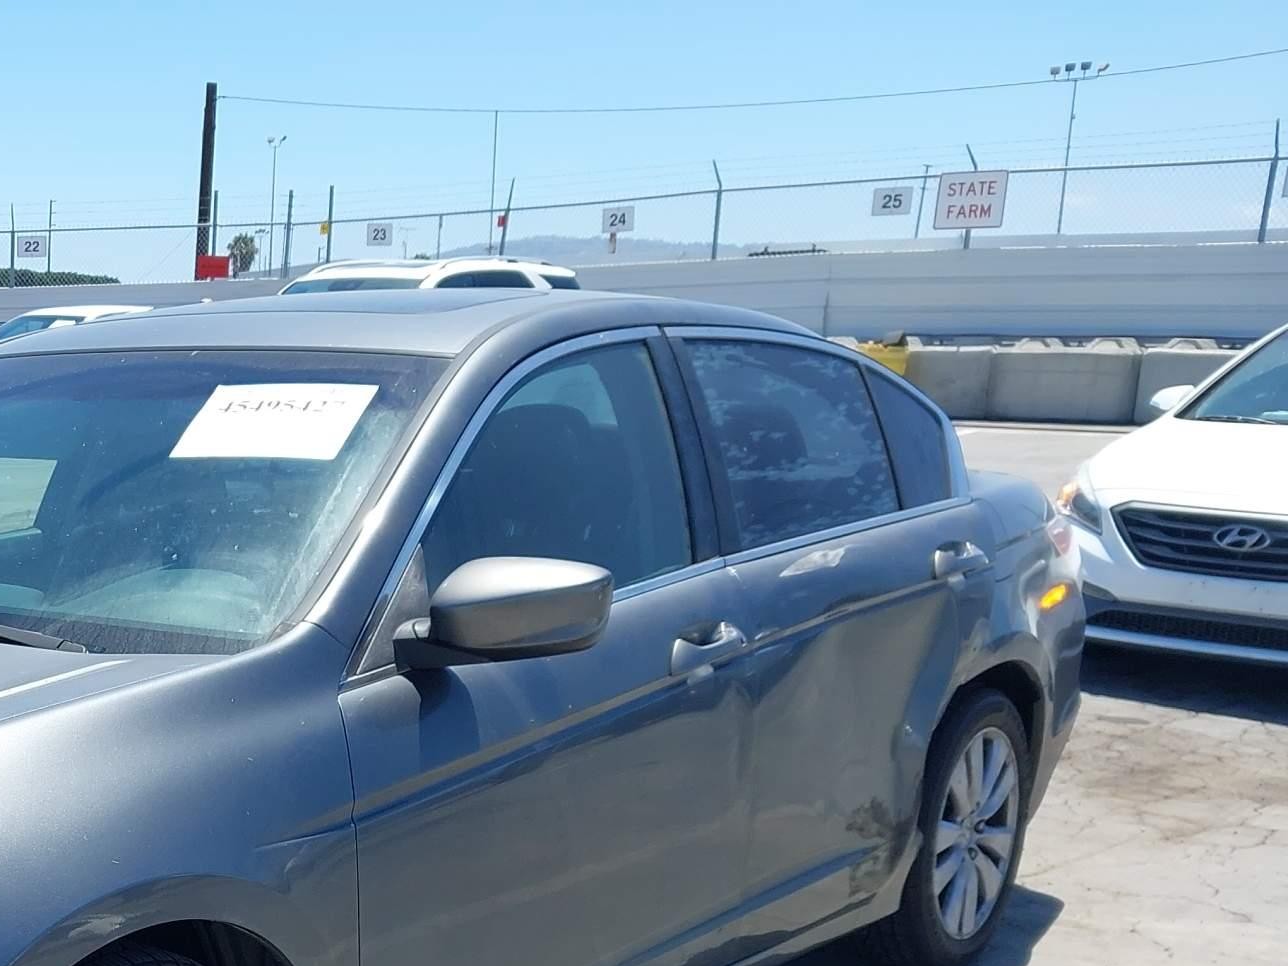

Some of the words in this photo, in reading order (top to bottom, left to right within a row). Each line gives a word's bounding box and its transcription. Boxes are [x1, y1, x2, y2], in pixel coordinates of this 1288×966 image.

[947, 181, 998, 197] STATE
[881, 193, 903, 209] 25
[609, 212, 626, 227] 24
[946, 204, 993, 220] FARM
[372, 228, 387, 241] 23
[24, 241, 40, 253] 22
